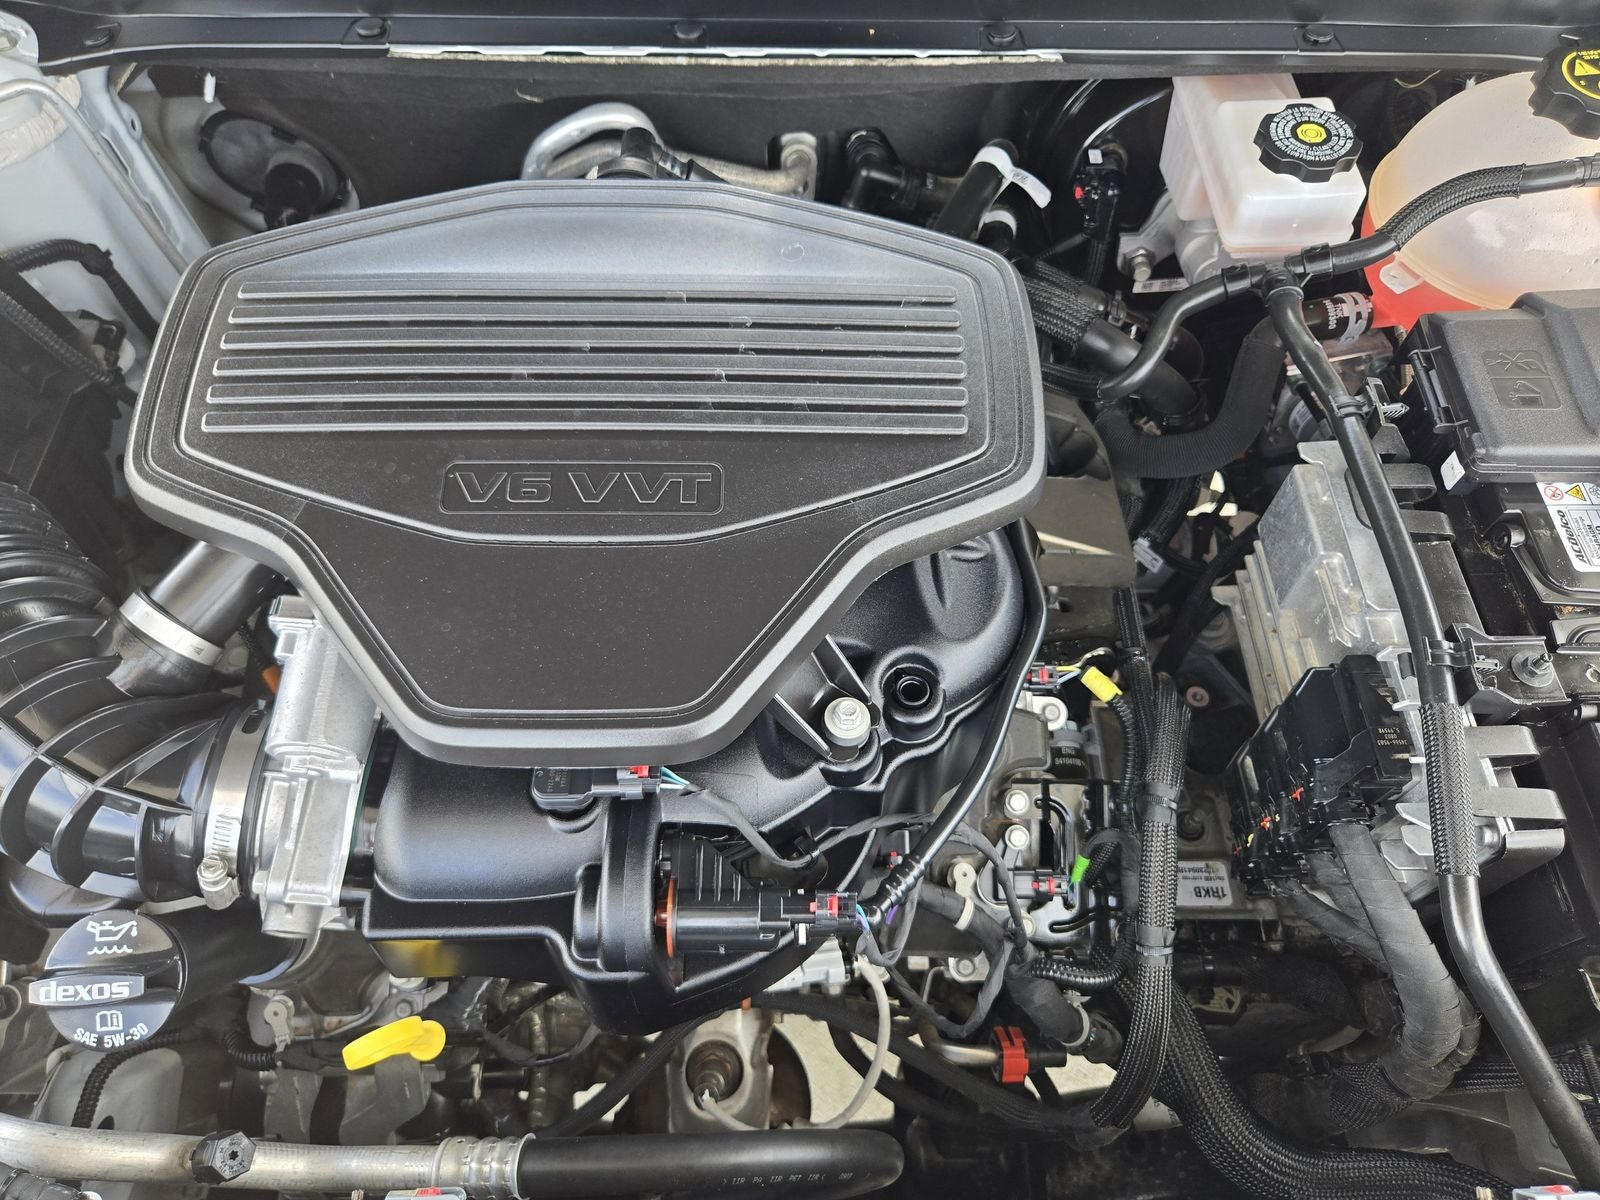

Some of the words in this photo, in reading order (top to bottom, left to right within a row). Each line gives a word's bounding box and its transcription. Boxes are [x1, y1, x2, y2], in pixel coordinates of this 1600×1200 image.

[455, 472, 552, 503] V6
[568, 472, 712, 504] VVT
[1193, 886, 1227, 899] 1RKB
[40, 980, 130, 1002] dexos
[74, 1027, 98, 1047] SAE
[104, 1022, 149, 1048] 5W-30
